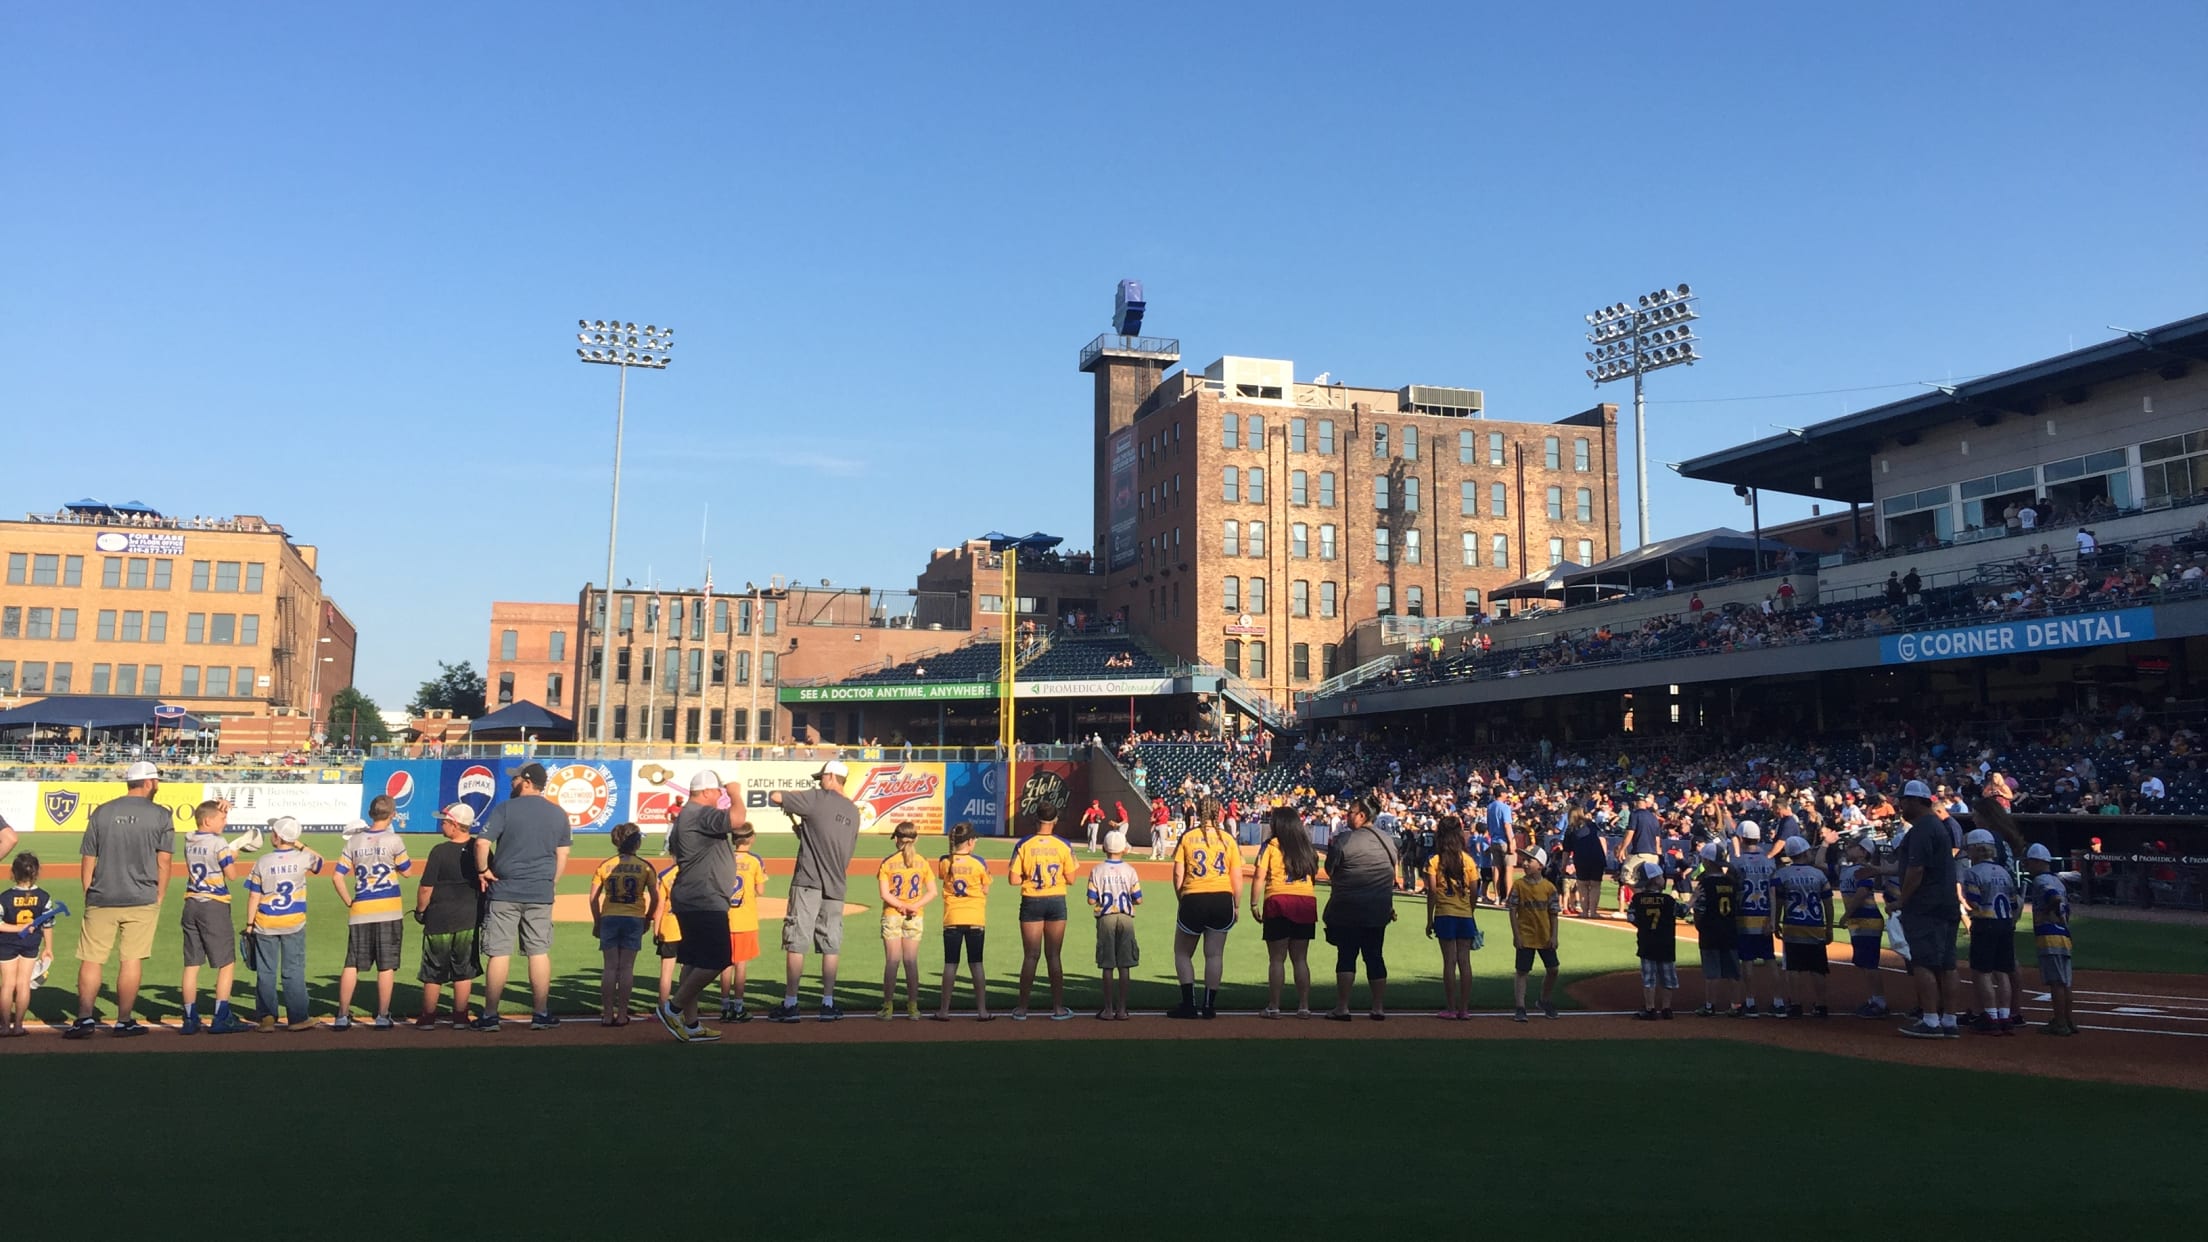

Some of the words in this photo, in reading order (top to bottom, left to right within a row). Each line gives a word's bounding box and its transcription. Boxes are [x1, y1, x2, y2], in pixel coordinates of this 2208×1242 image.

[1920, 627, 2015, 656] CORNER
[2026, 615, 2131, 648] DENTAL
[800, 689, 818, 699] SEE
[820, 689, 828, 699] A
[831, 687, 873, 699] DOCTOR
[876, 686, 926, 699] ANYTIME,
[463, 780, 491, 790] RE/MAX
[747, 778, 774, 788] CATCH
[778, 778, 793, 788] THE
[48, 796, 74, 813] UT
[962, 798, 996, 816] Alls
[270, 864, 298, 875] MINER
[1192, 850, 1226, 877] 34
[354, 862, 392, 893] 32
[892, 873, 920, 900] 38
[1031, 863, 1059, 890] 47
[270, 880, 296, 910] 3
[607, 875, 637, 904] 13
[1646, 907, 1661, 930] 7
